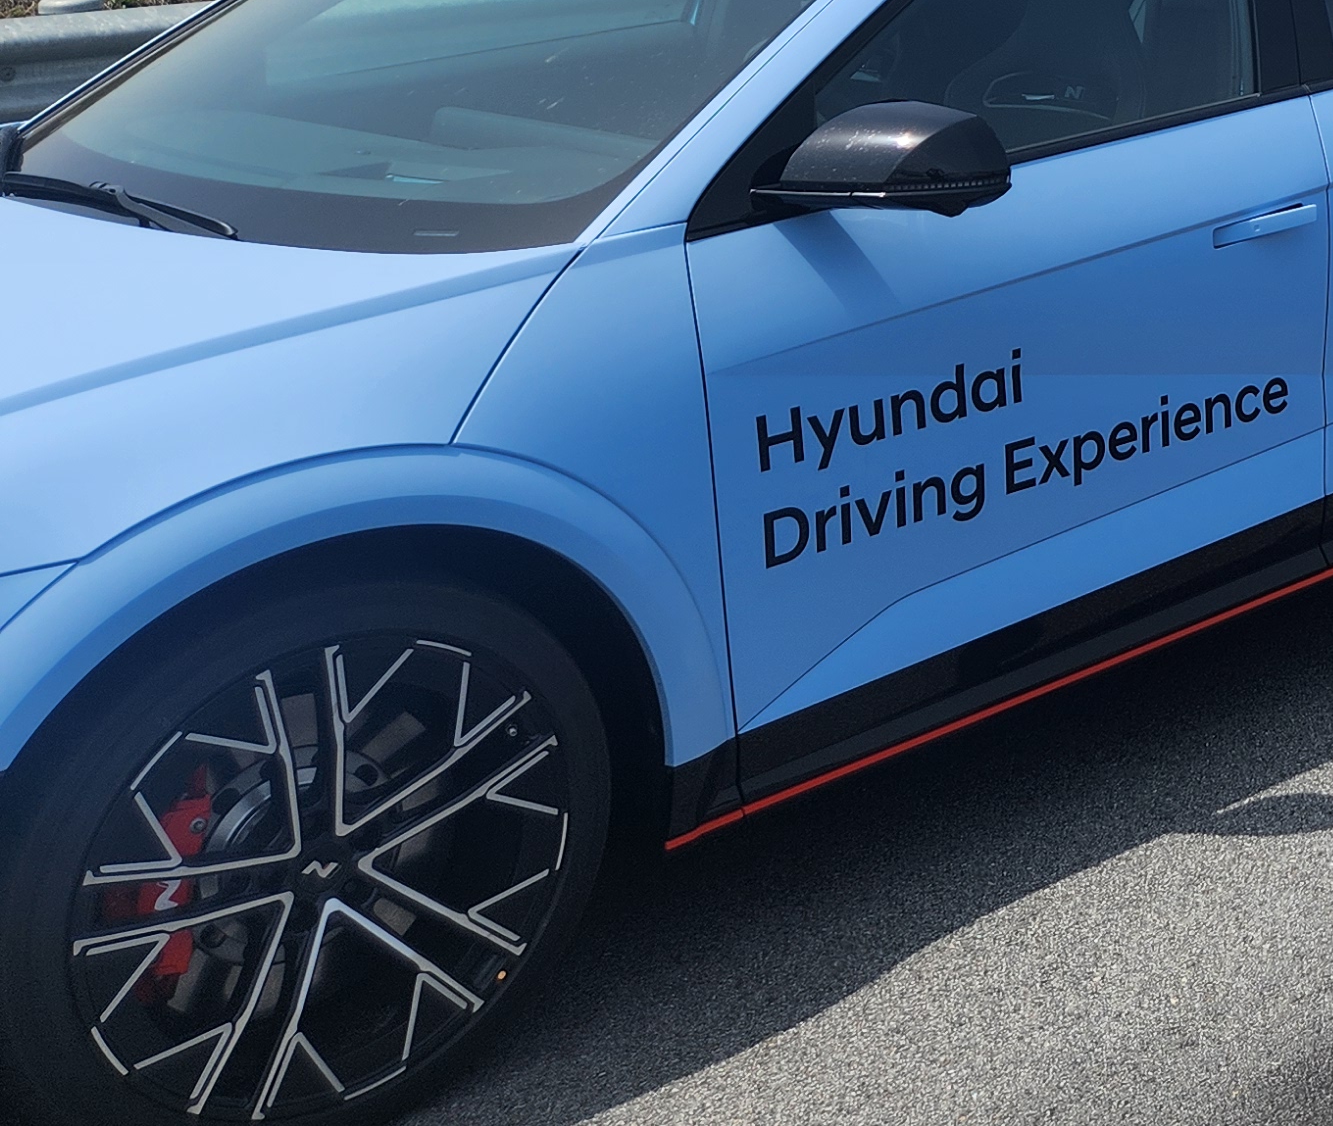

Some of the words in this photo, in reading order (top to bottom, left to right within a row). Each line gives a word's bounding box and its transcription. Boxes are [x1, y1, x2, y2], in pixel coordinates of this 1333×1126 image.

[755, 347, 1024, 473] Hyundai
[763, 462, 985, 570] Driving
[1003, 375, 1290, 494] Experience
